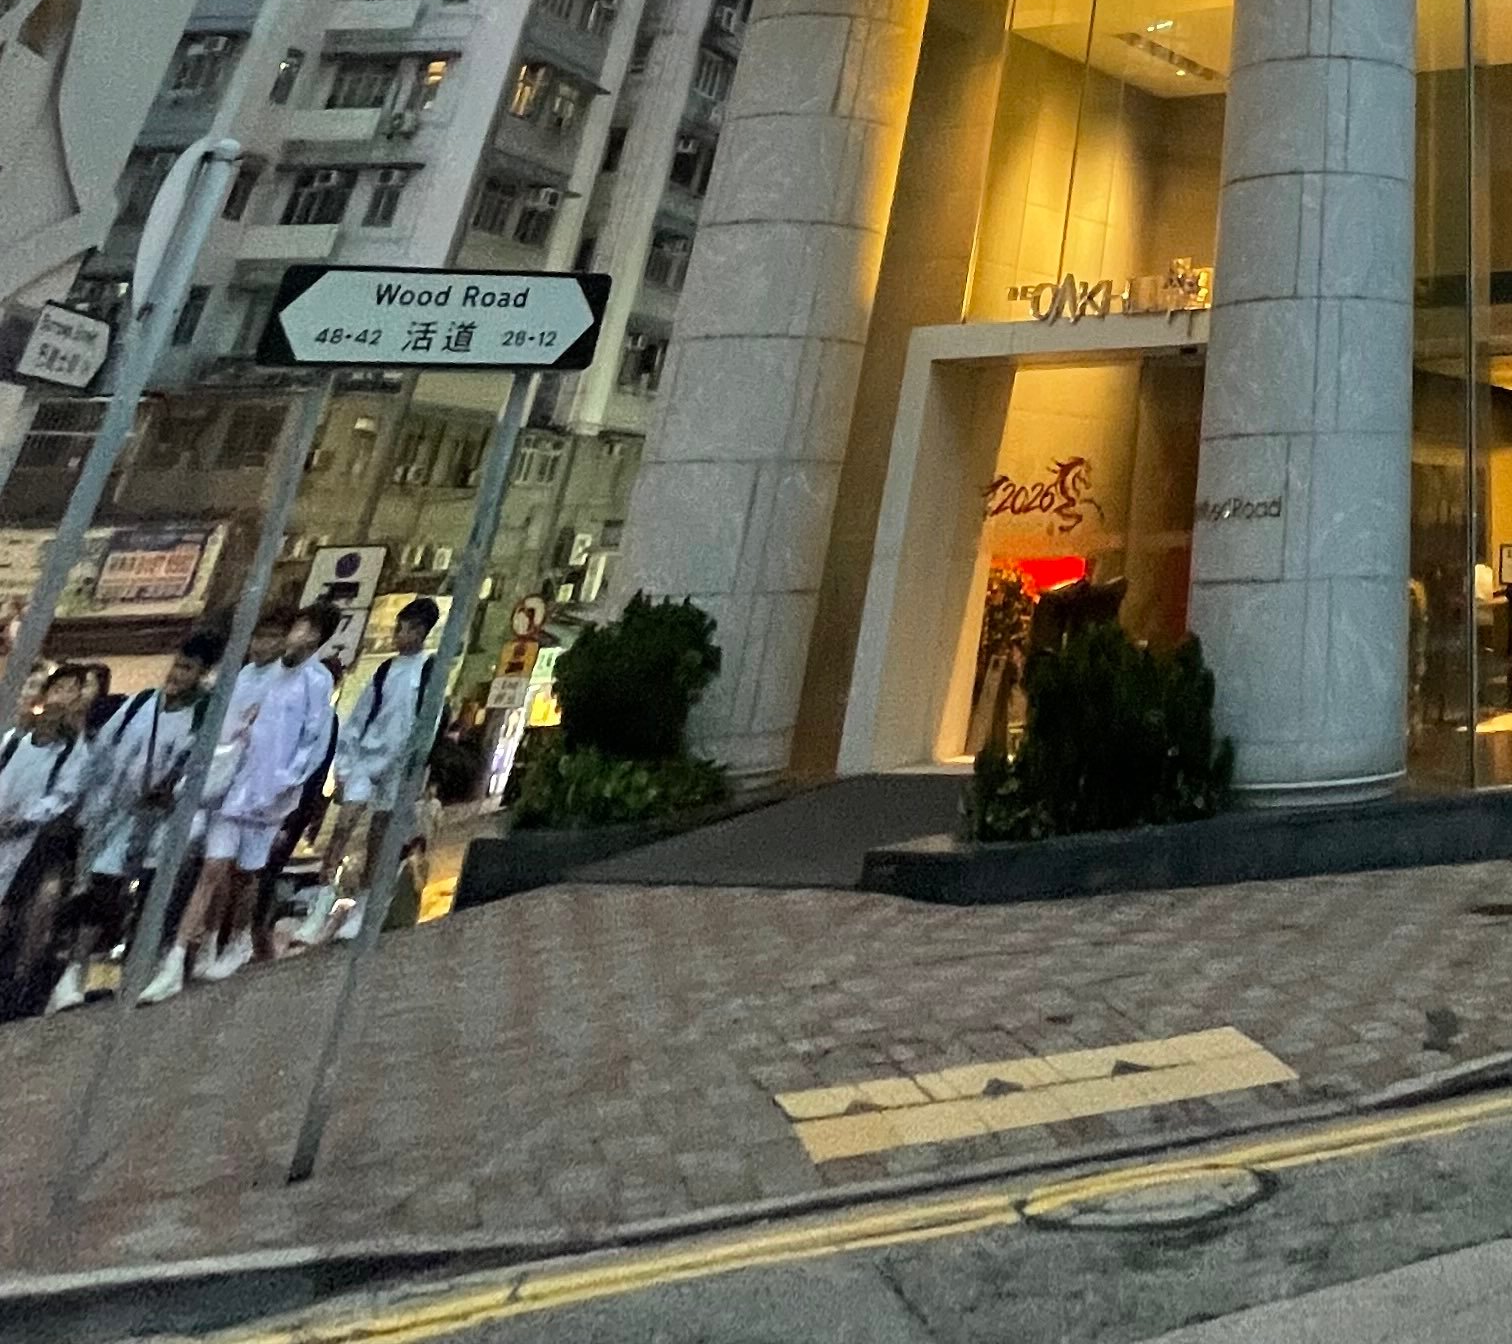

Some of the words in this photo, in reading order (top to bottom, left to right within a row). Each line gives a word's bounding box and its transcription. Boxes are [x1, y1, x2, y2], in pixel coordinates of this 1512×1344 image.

[375, 283, 453, 307] Wood
[461, 285, 531, 309] Road
[400, 319, 478, 353] 活道
[990, 482, 1055, 517] 2026
